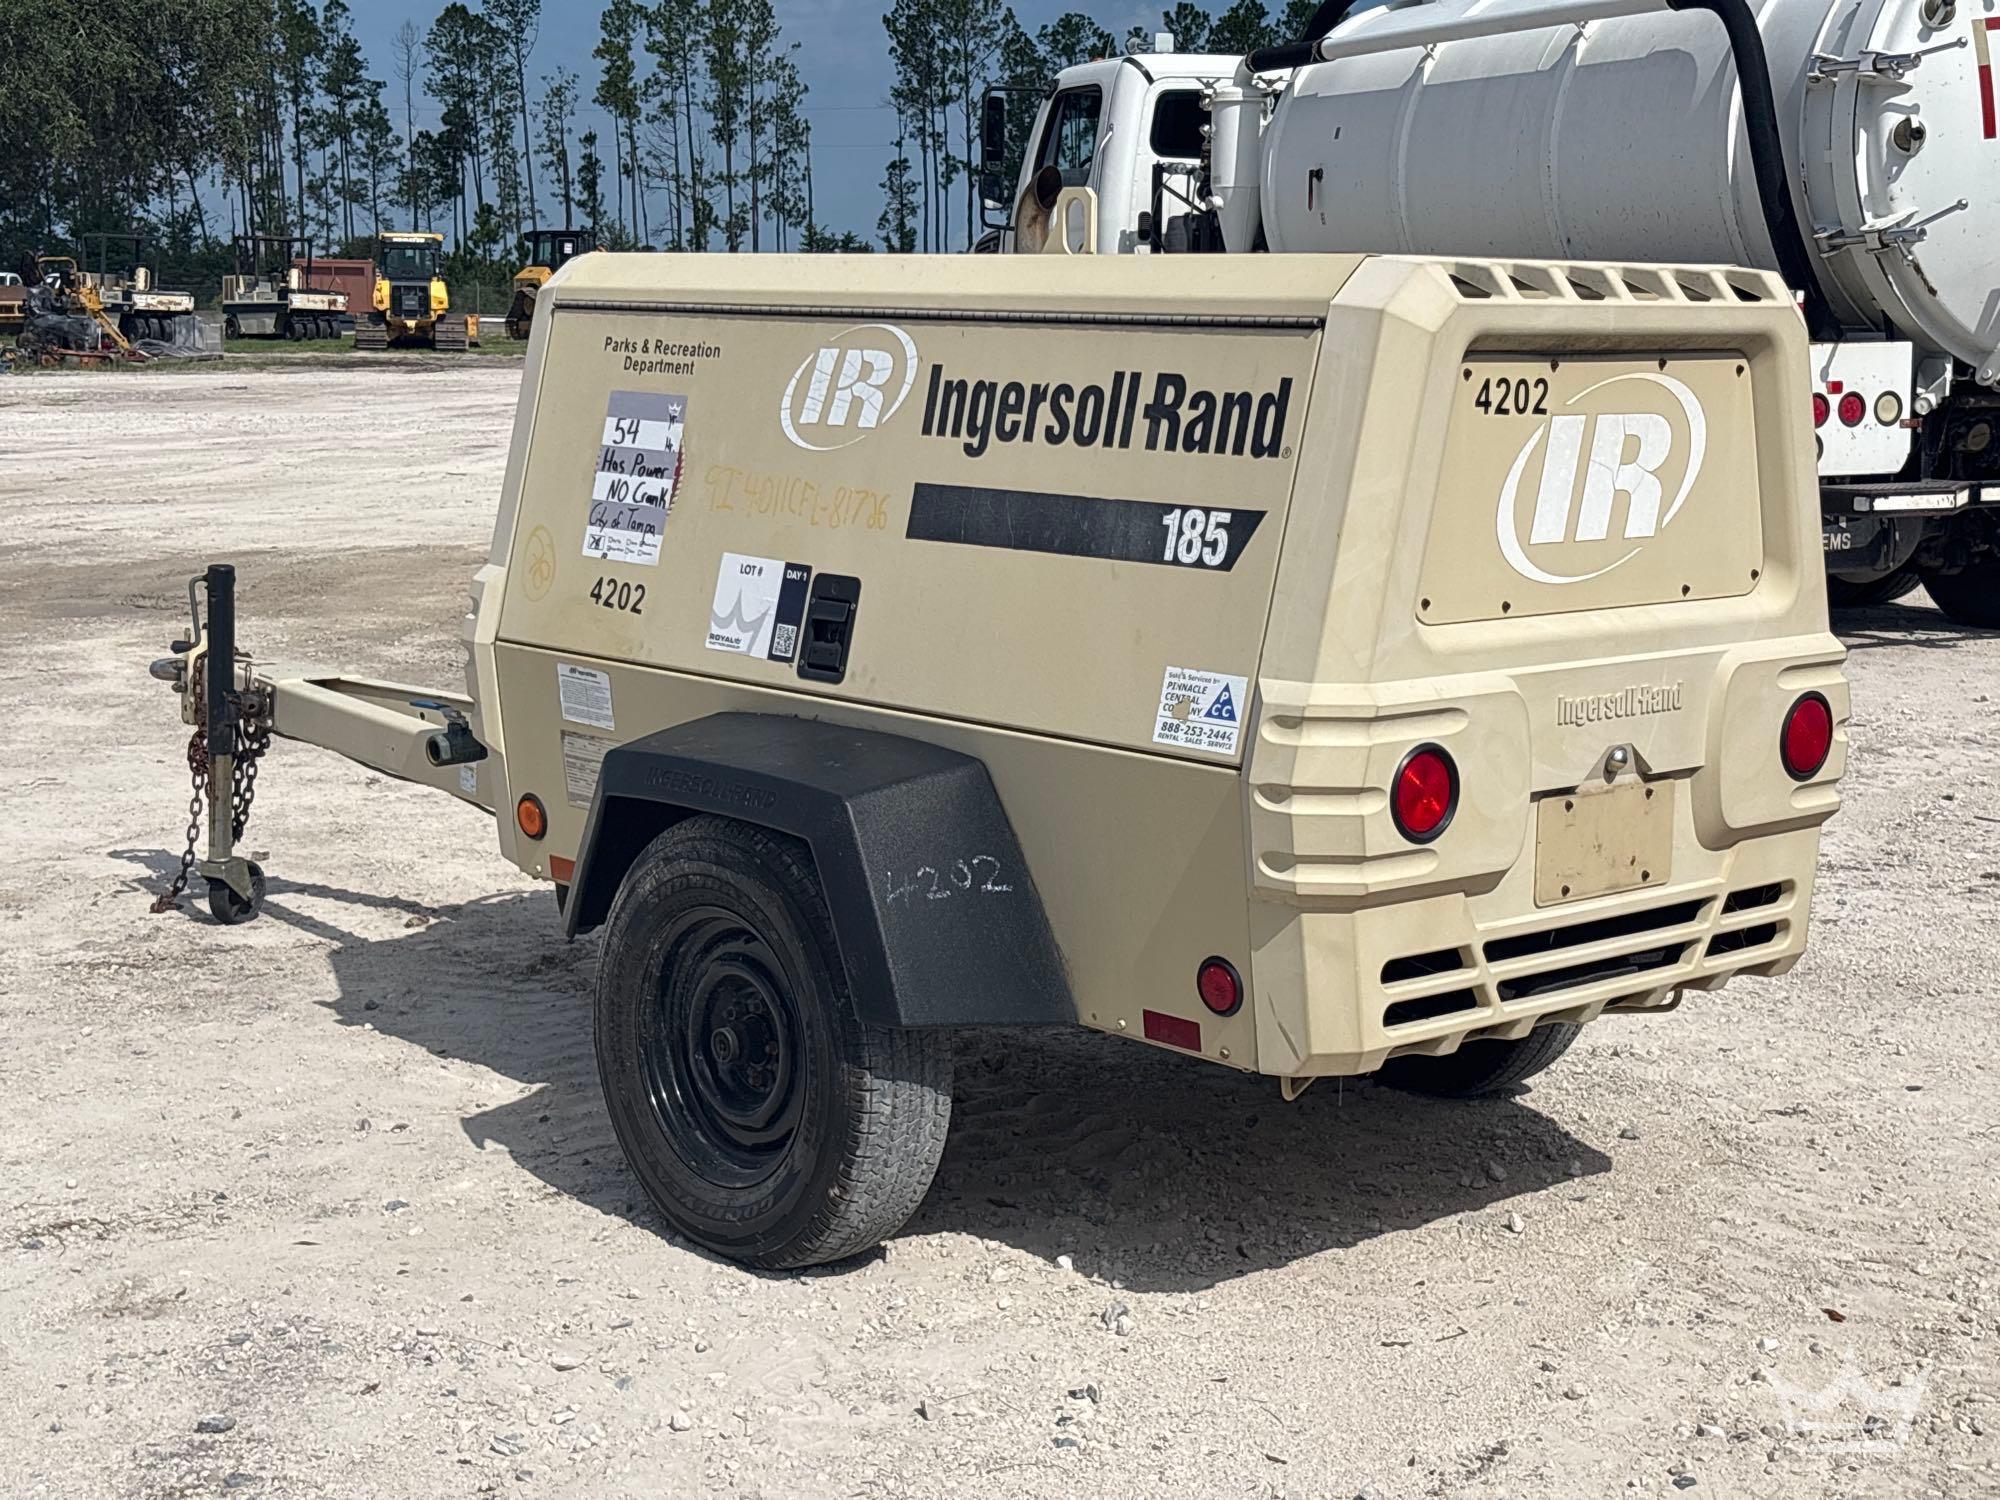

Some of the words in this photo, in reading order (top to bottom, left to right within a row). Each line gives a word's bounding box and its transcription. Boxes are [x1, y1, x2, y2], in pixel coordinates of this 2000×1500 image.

[604, 336, 638, 354] Parks
[641, 338, 650, 354] &
[654, 339, 721, 358] Recreation
[624, 356, 695, 375] Department
[799, 348, 893, 428] IR
[1474, 377, 1549, 415] 4202
[612, 418, 640, 445] 54
[601, 447, 625, 474] Has
[630, 453, 669, 479] Power
[606, 479, 629, 502] NO
[1529, 413, 1672, 545] IR
[589, 502, 608, 533] City
[611, 511, 625, 529] of
[626, 508, 656, 547] Tampa
[1162, 508, 1231, 566] 185
[740, 563, 757, 575] LOT
[757, 567, 764, 577] #
[786, 569, 803, 580] DAY
[803, 571, 808, 581] 1
[590, 576, 646, 615] 4202
[709, 633, 735, 643] ROYAL
[1166, 682, 1208, 694] PINNACLE
[1188, 675, 1212, 683] Serviced
[1157, 732, 1179, 742] RENTAL
[1184, 737, 1202, 746] SALES
[1206, 741, 1233, 750] SERVICE
[1161, 721, 1234, 742] 888-253-2444
[886, 854, 1014, 908] 4202
